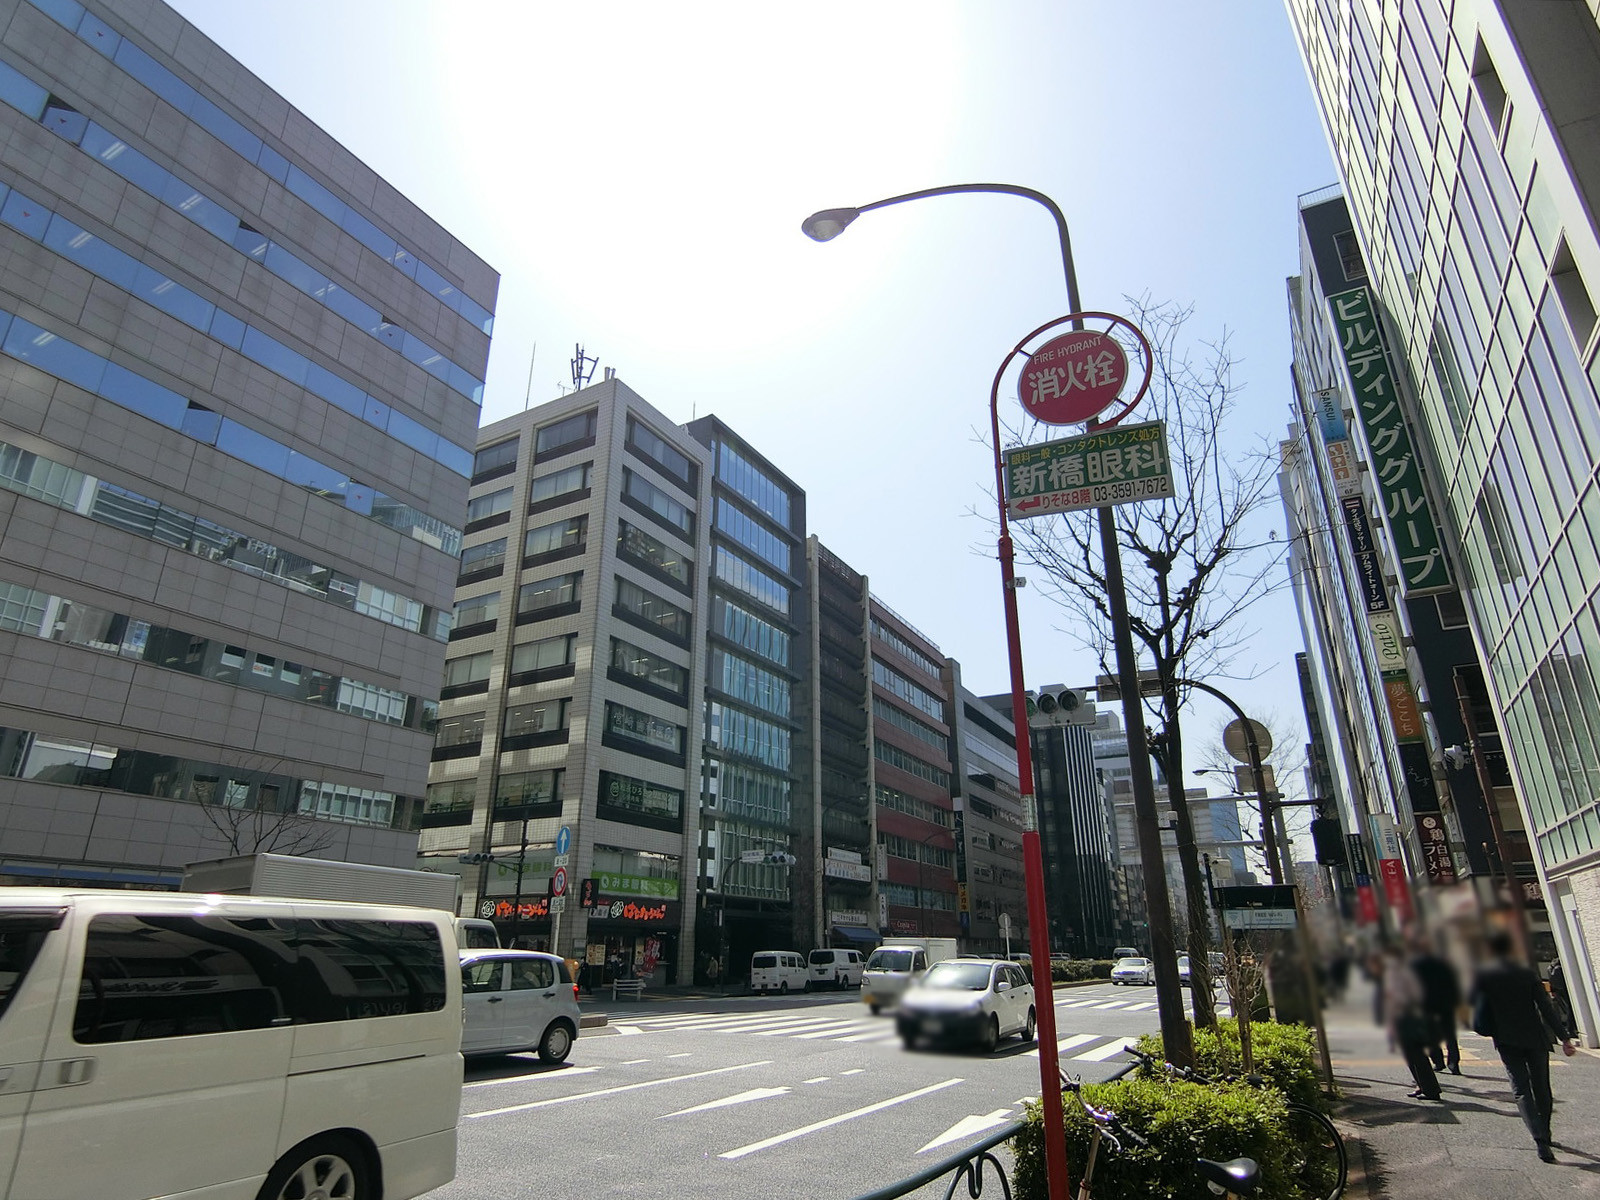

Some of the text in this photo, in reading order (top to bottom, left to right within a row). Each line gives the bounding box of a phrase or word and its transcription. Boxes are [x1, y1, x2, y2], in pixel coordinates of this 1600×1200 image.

[1034, 336, 1102, 365] FIRE HYDRANT
[1028, 350, 1118, 405] 消火栓
[1320, 391, 1336, 421] SANSUI
[1011, 426, 1160, 465] 眼科一般・コンタクトレンズ処方
[1336, 291, 1441, 585] ビルディンググループ
[1012, 441, 1164, 495] 新橋眼科
[1042, 488, 1091, 509] りそな8階
[1093, 478, 1168, 502] 03-3591-7672
[1369, 600, 1385, 610] 5F
[1375, 623, 1398, 660] Patio
